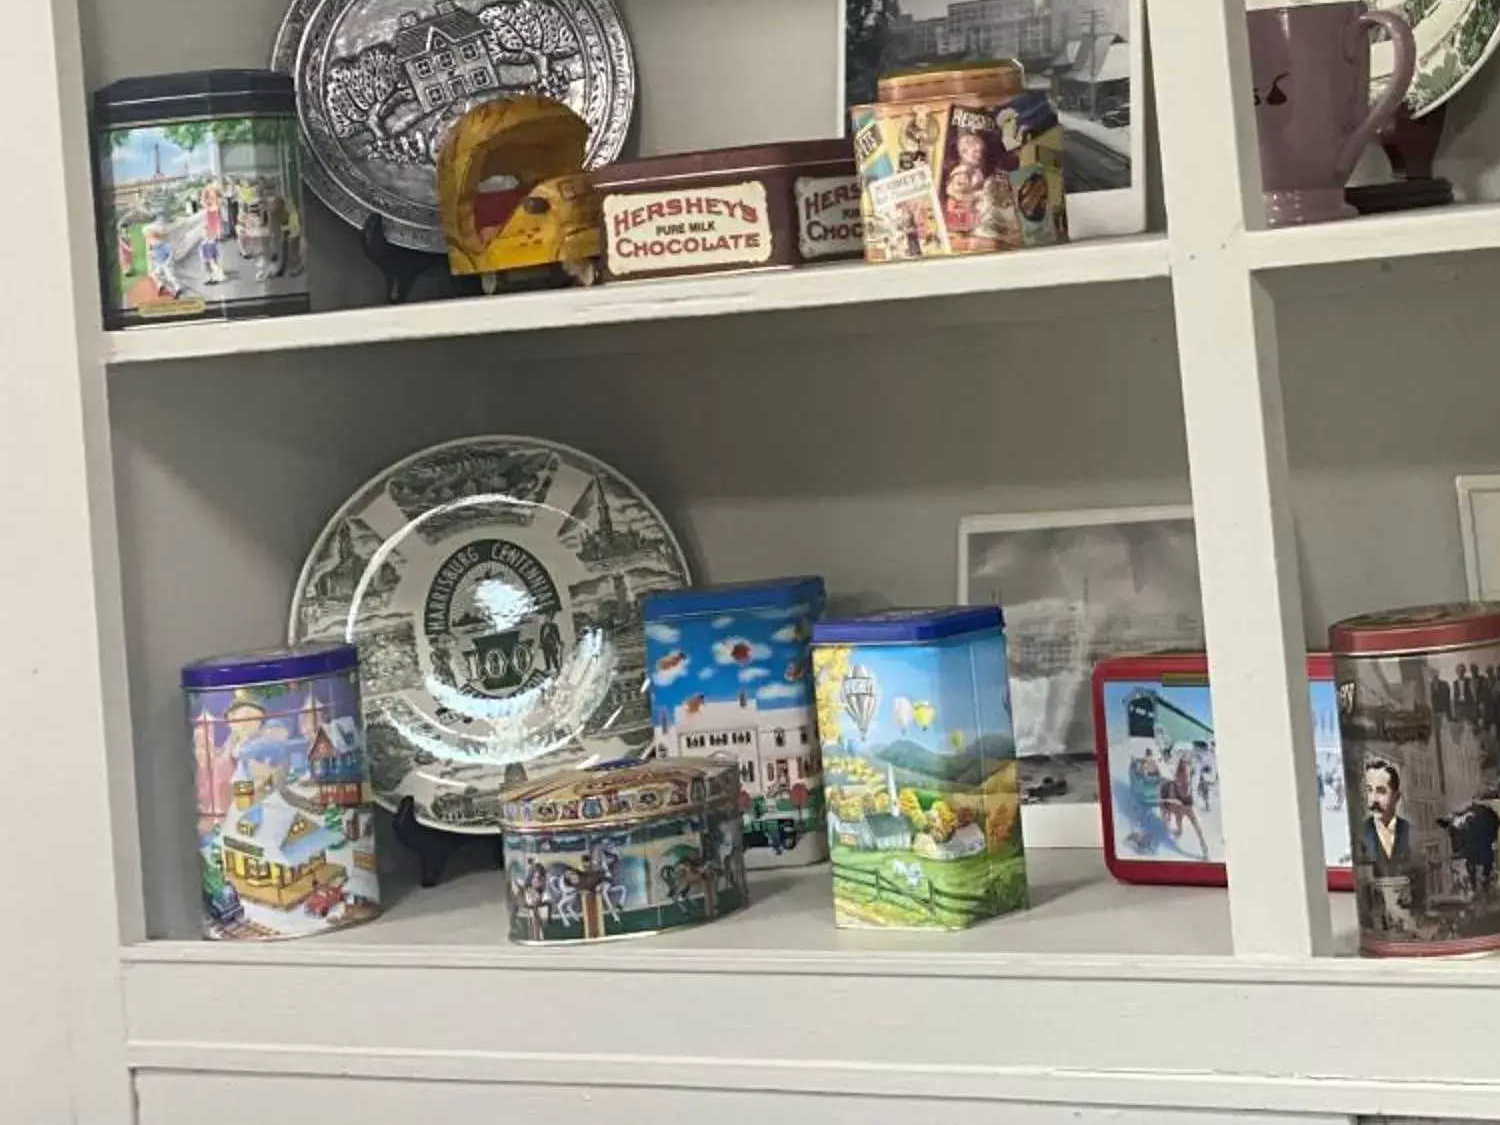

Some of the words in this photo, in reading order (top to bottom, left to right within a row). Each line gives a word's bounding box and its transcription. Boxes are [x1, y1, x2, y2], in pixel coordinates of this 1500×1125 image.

[613, 195, 759, 238] HERSHEY'S
[805, 182, 862, 220] HERS
[615, 232, 761, 259] CHOCOLATE
[655, 222, 686, 237] PURE
[688, 220, 716, 234] MILK
[425, 545, 480, 635] HARRISBURG
